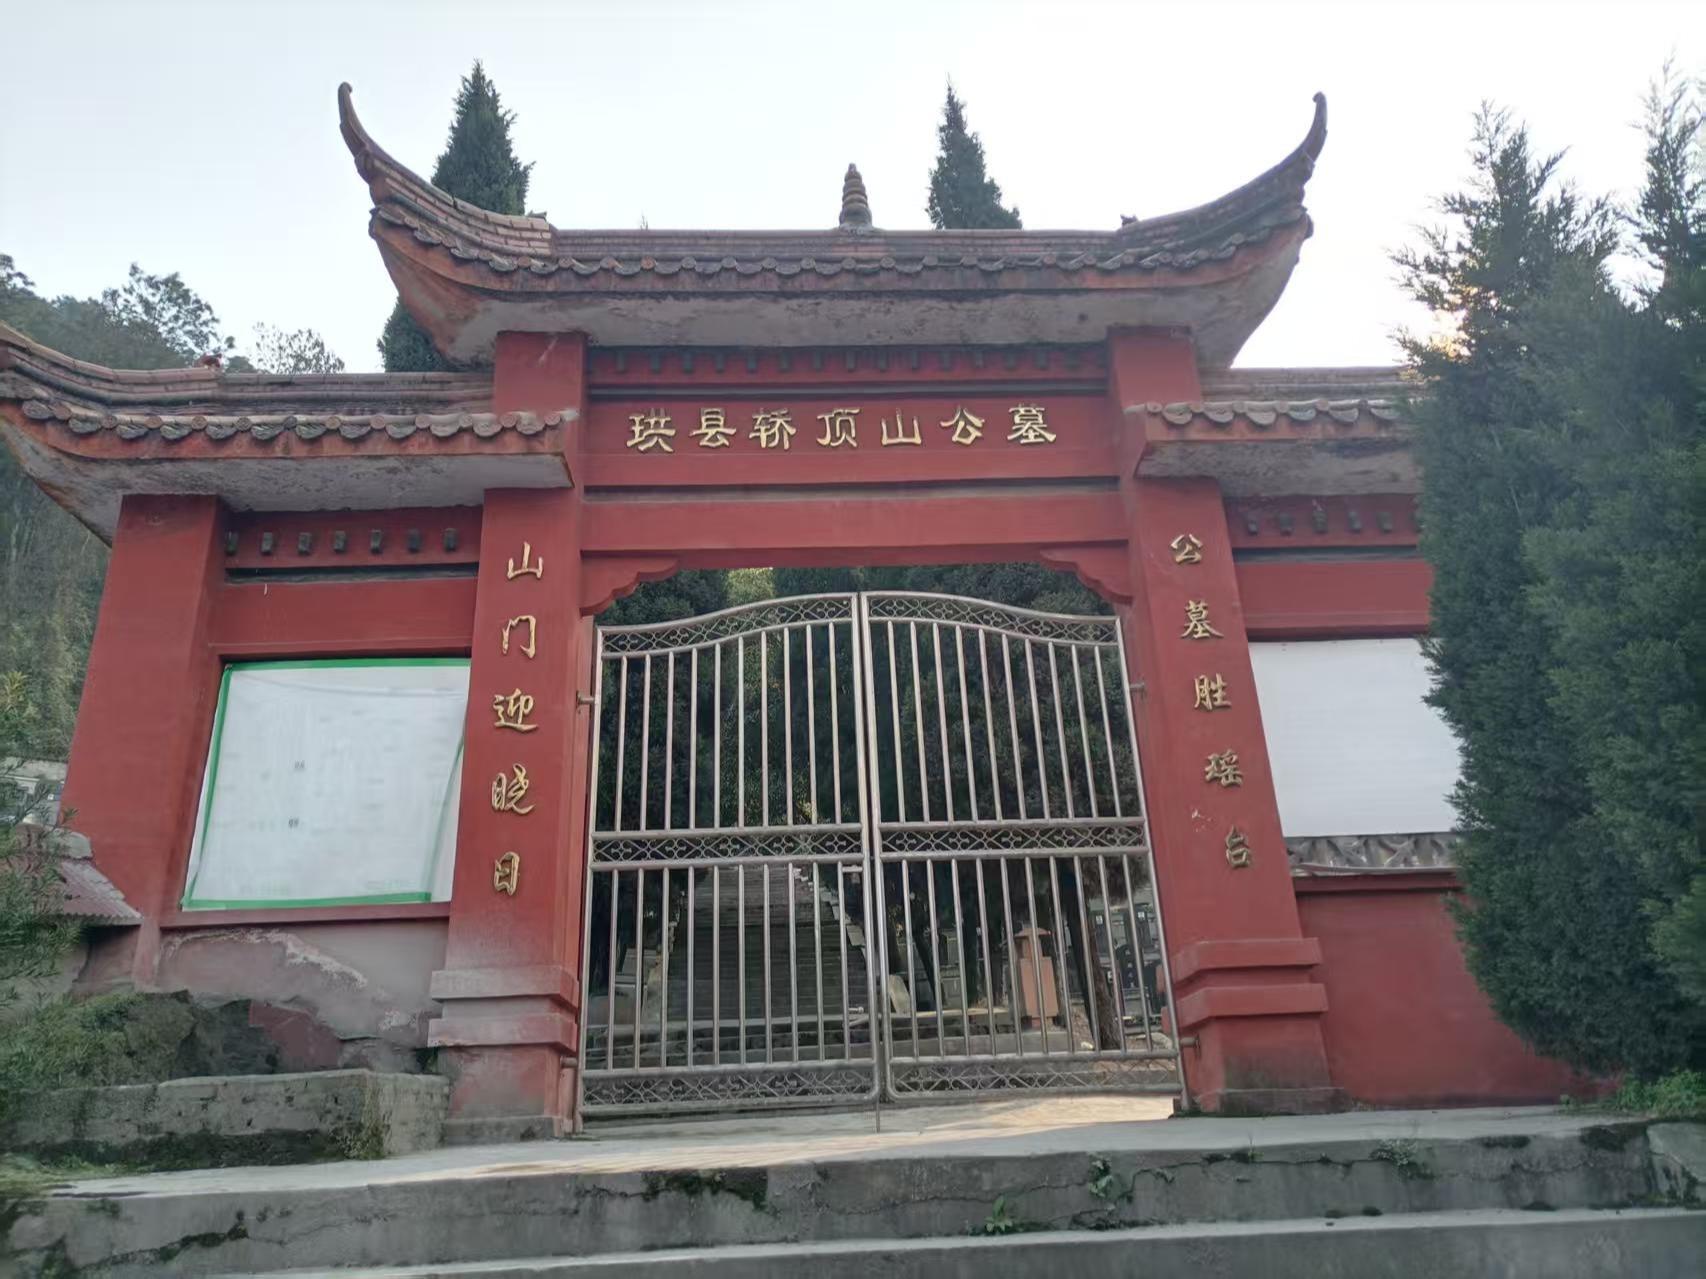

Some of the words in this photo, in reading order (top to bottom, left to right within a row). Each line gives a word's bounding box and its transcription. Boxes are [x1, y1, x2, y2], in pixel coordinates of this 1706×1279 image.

[625, 403, 1057, 453] 珙县轿顶山公墓
[491, 541, 544, 896] 山门迎晓日
[1170, 533, 1251, 868] 公墓胜瑶台
